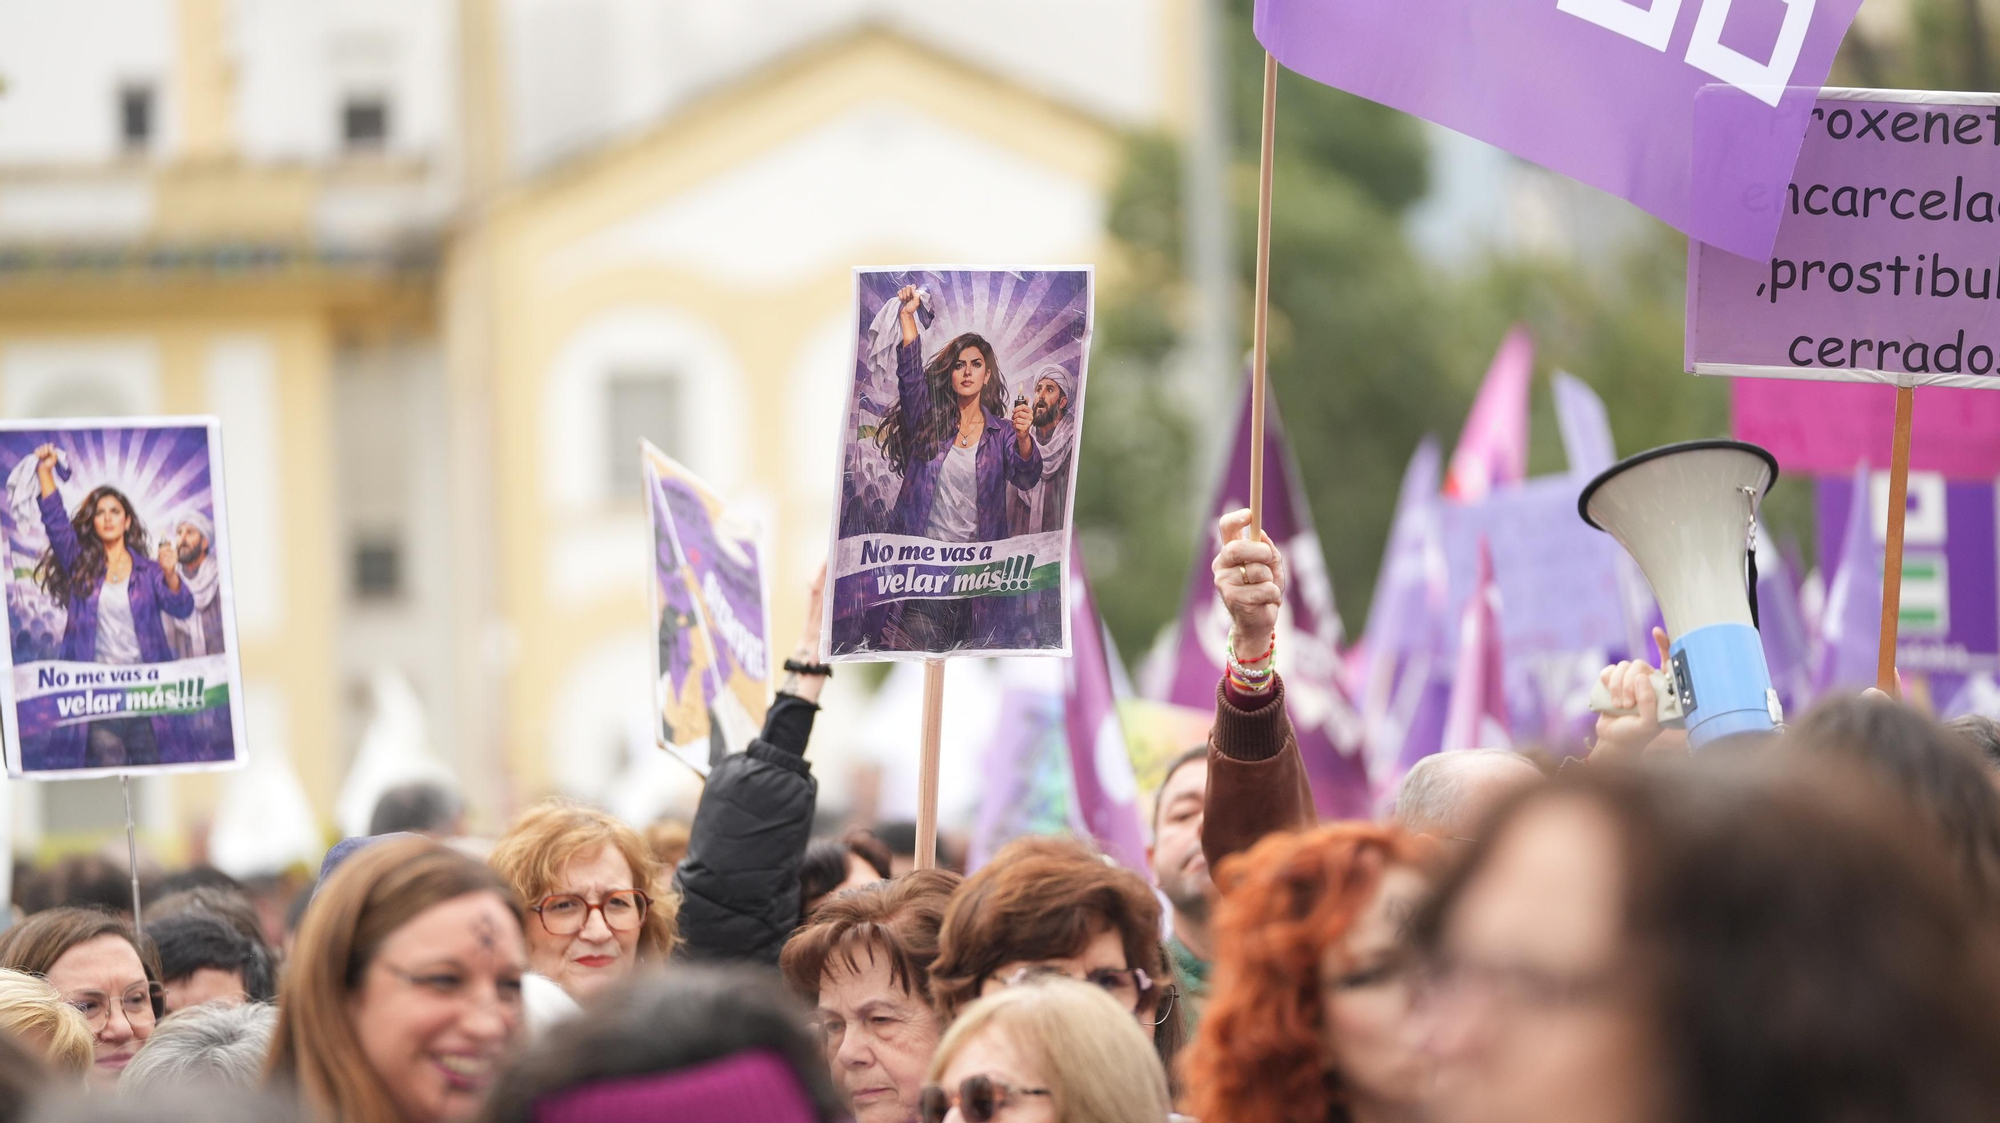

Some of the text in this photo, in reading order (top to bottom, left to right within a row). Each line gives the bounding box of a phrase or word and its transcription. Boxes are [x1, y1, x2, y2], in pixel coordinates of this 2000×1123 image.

[1742, 174, 2000, 223] encarcela
[1788, 328, 2000, 374] cerrado
[860, 538, 993, 565] No me vas a
[877, 553, 1036, 595] velar más!!!
[38, 666, 159, 689] No me vas a
[56, 688, 122, 718] velar
